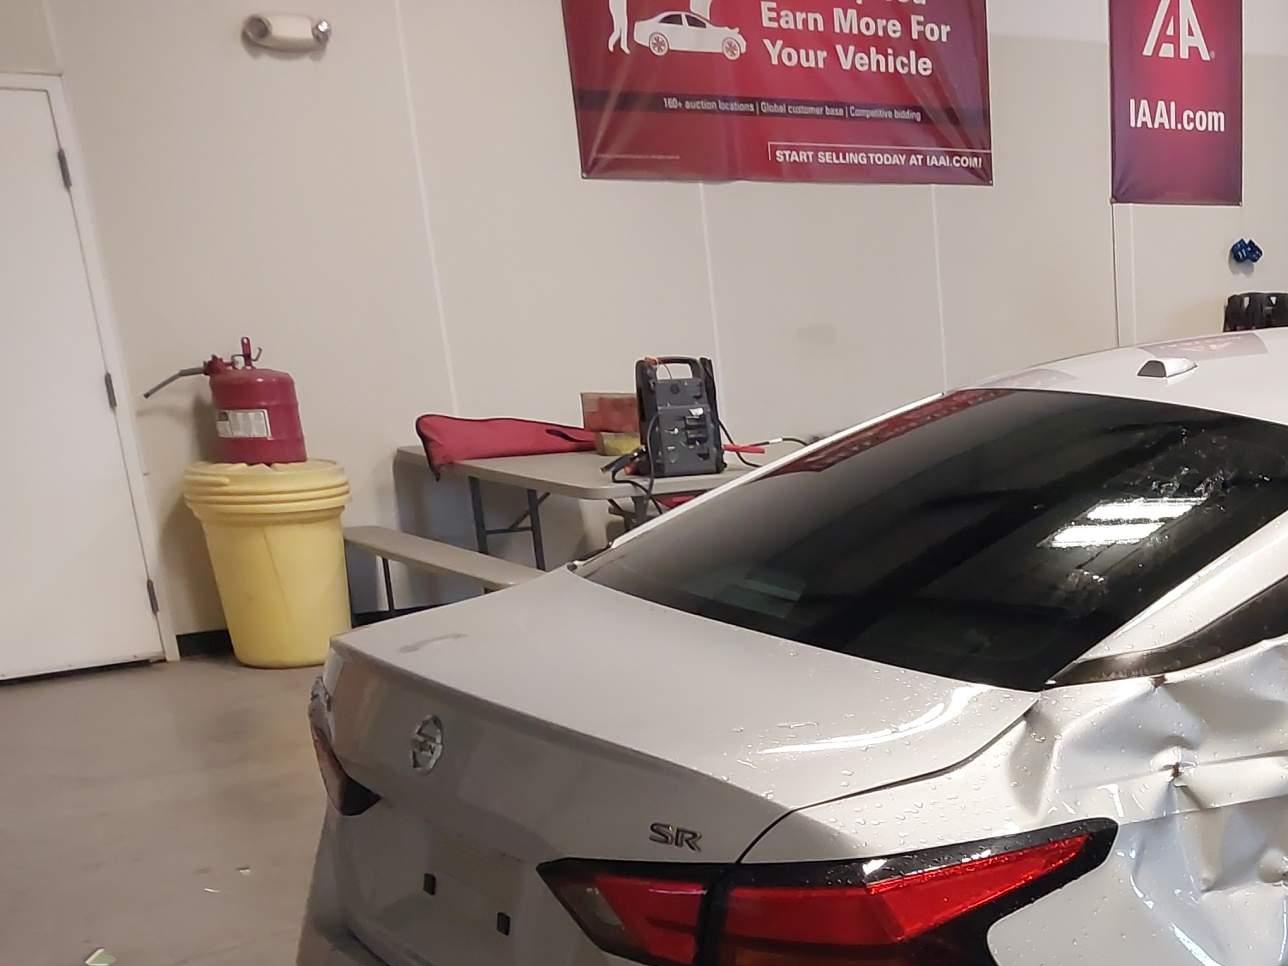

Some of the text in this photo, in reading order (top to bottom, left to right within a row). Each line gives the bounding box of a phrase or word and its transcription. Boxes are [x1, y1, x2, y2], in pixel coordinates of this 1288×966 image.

[761, 1, 950, 42] Earn More For
[762, 39, 933, 76] Your Vehicle
[684, 100, 717, 110] auction
[718, 100, 754, 112] locations
[760, 102, 786, 113] Global
[788, 105, 823, 115] customer
[825, 105, 844, 116] base
[1129, 98, 1225, 132] IAAI.com
[776, 150, 814, 163] START
[817, 151, 866, 165] SELLING
[868, 153, 906, 166] TODAY
[909, 154, 924, 166] AT
[649, 823, 702, 851] SR
